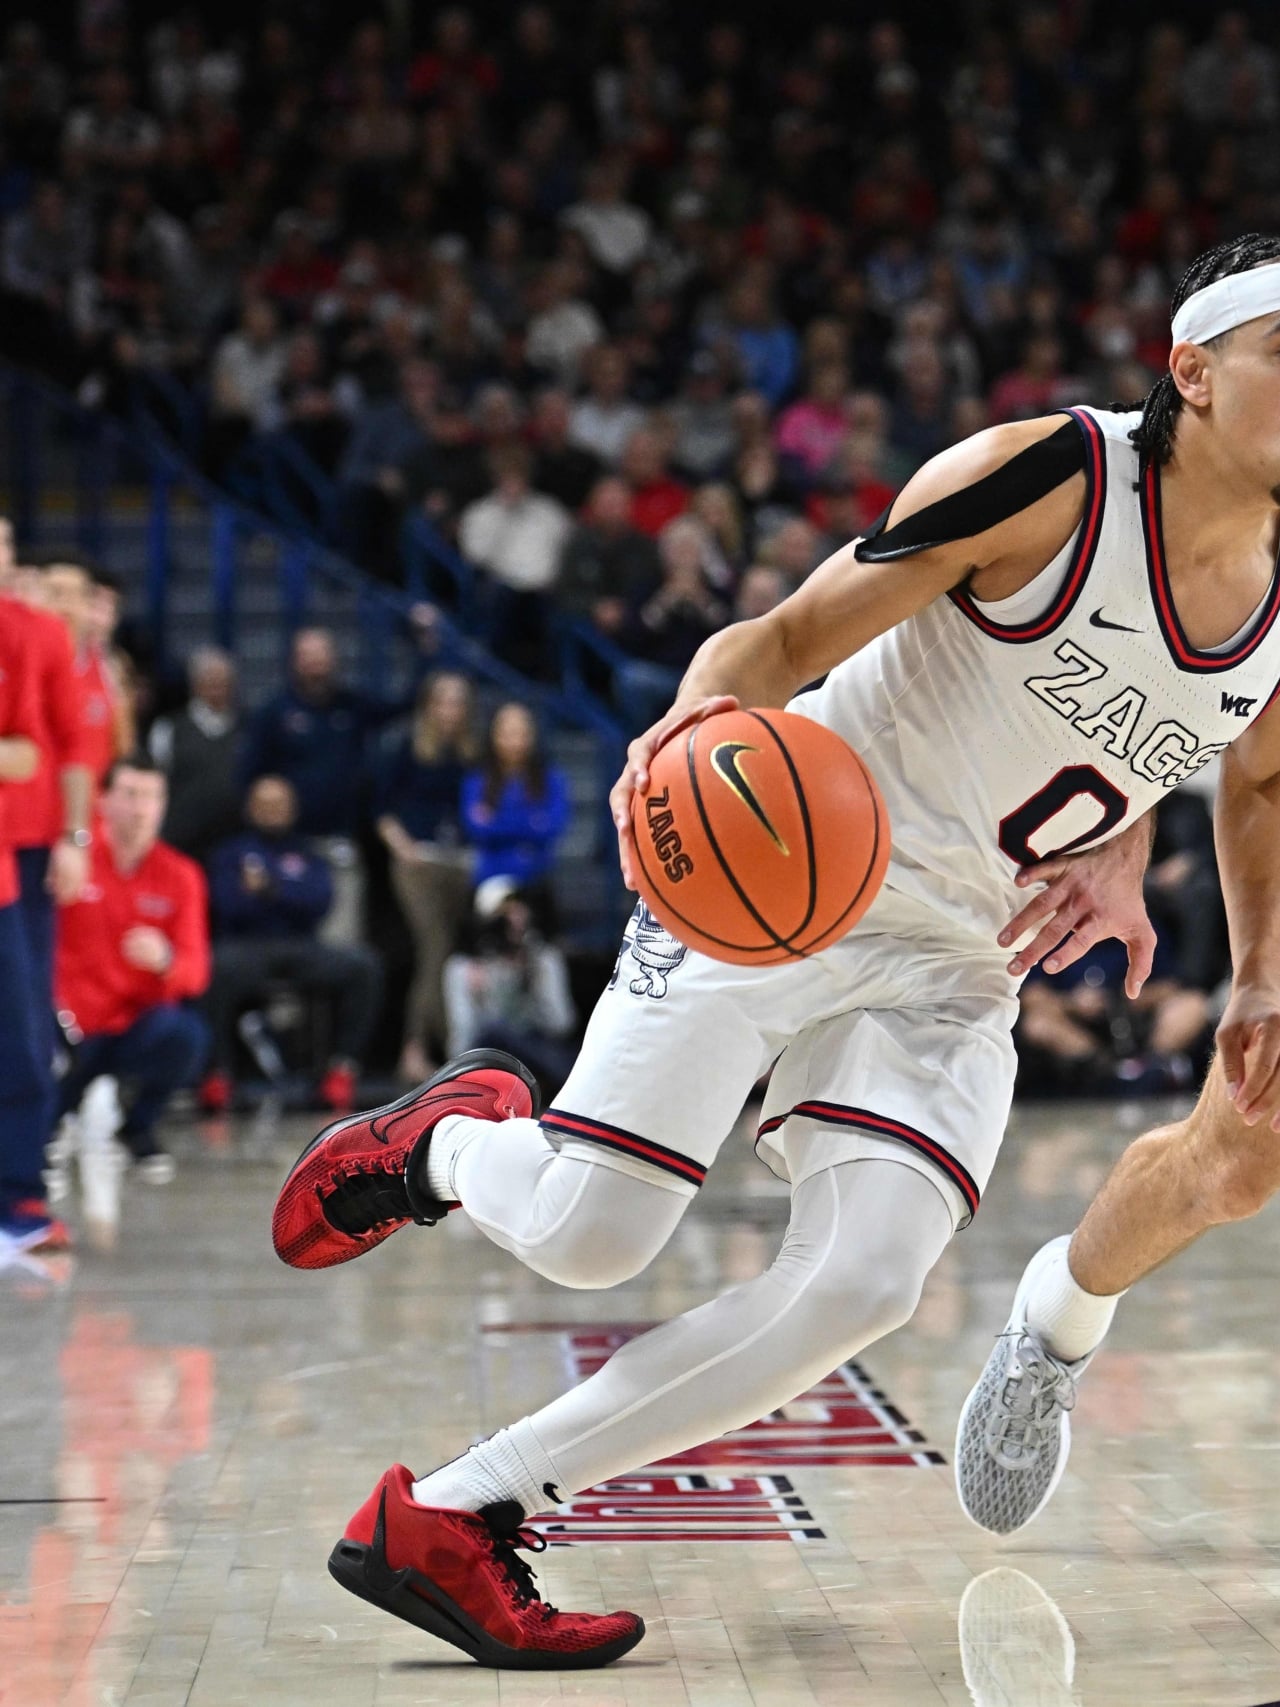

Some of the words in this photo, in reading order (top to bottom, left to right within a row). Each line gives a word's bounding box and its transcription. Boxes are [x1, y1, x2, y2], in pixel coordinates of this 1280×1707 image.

[1220, 691, 1258, 717] WCC
[645, 785, 695, 884] ZAGS
[998, 764, 1129, 867] 0
